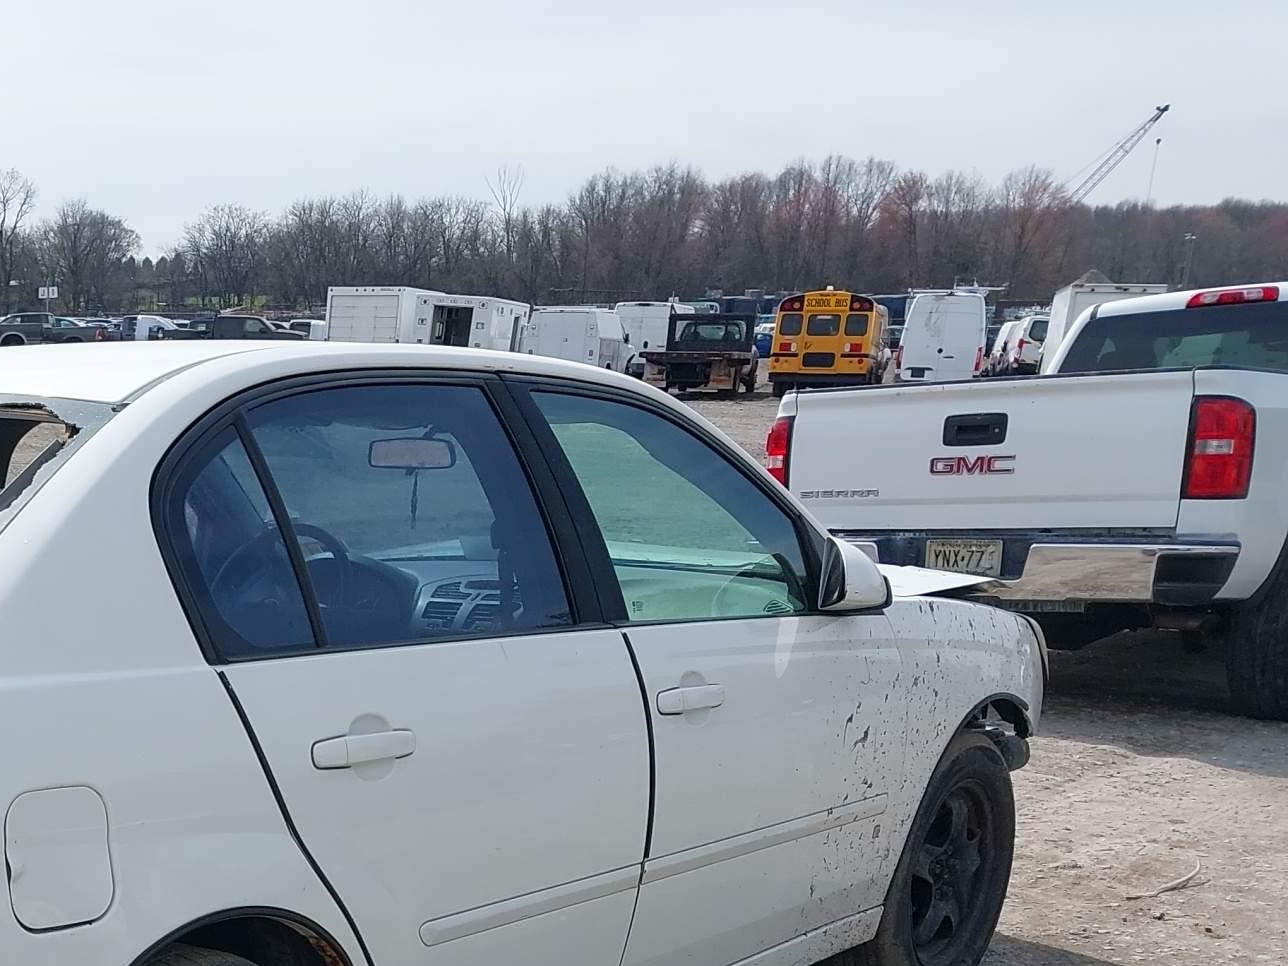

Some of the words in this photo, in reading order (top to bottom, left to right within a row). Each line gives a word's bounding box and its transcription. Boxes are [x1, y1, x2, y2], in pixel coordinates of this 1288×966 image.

[806, 298, 832, 308] SCHOOL
[834, 298, 849, 308] BUS
[929, 455, 1016, 475] GMC
[799, 489, 880, 499] SIERRA
